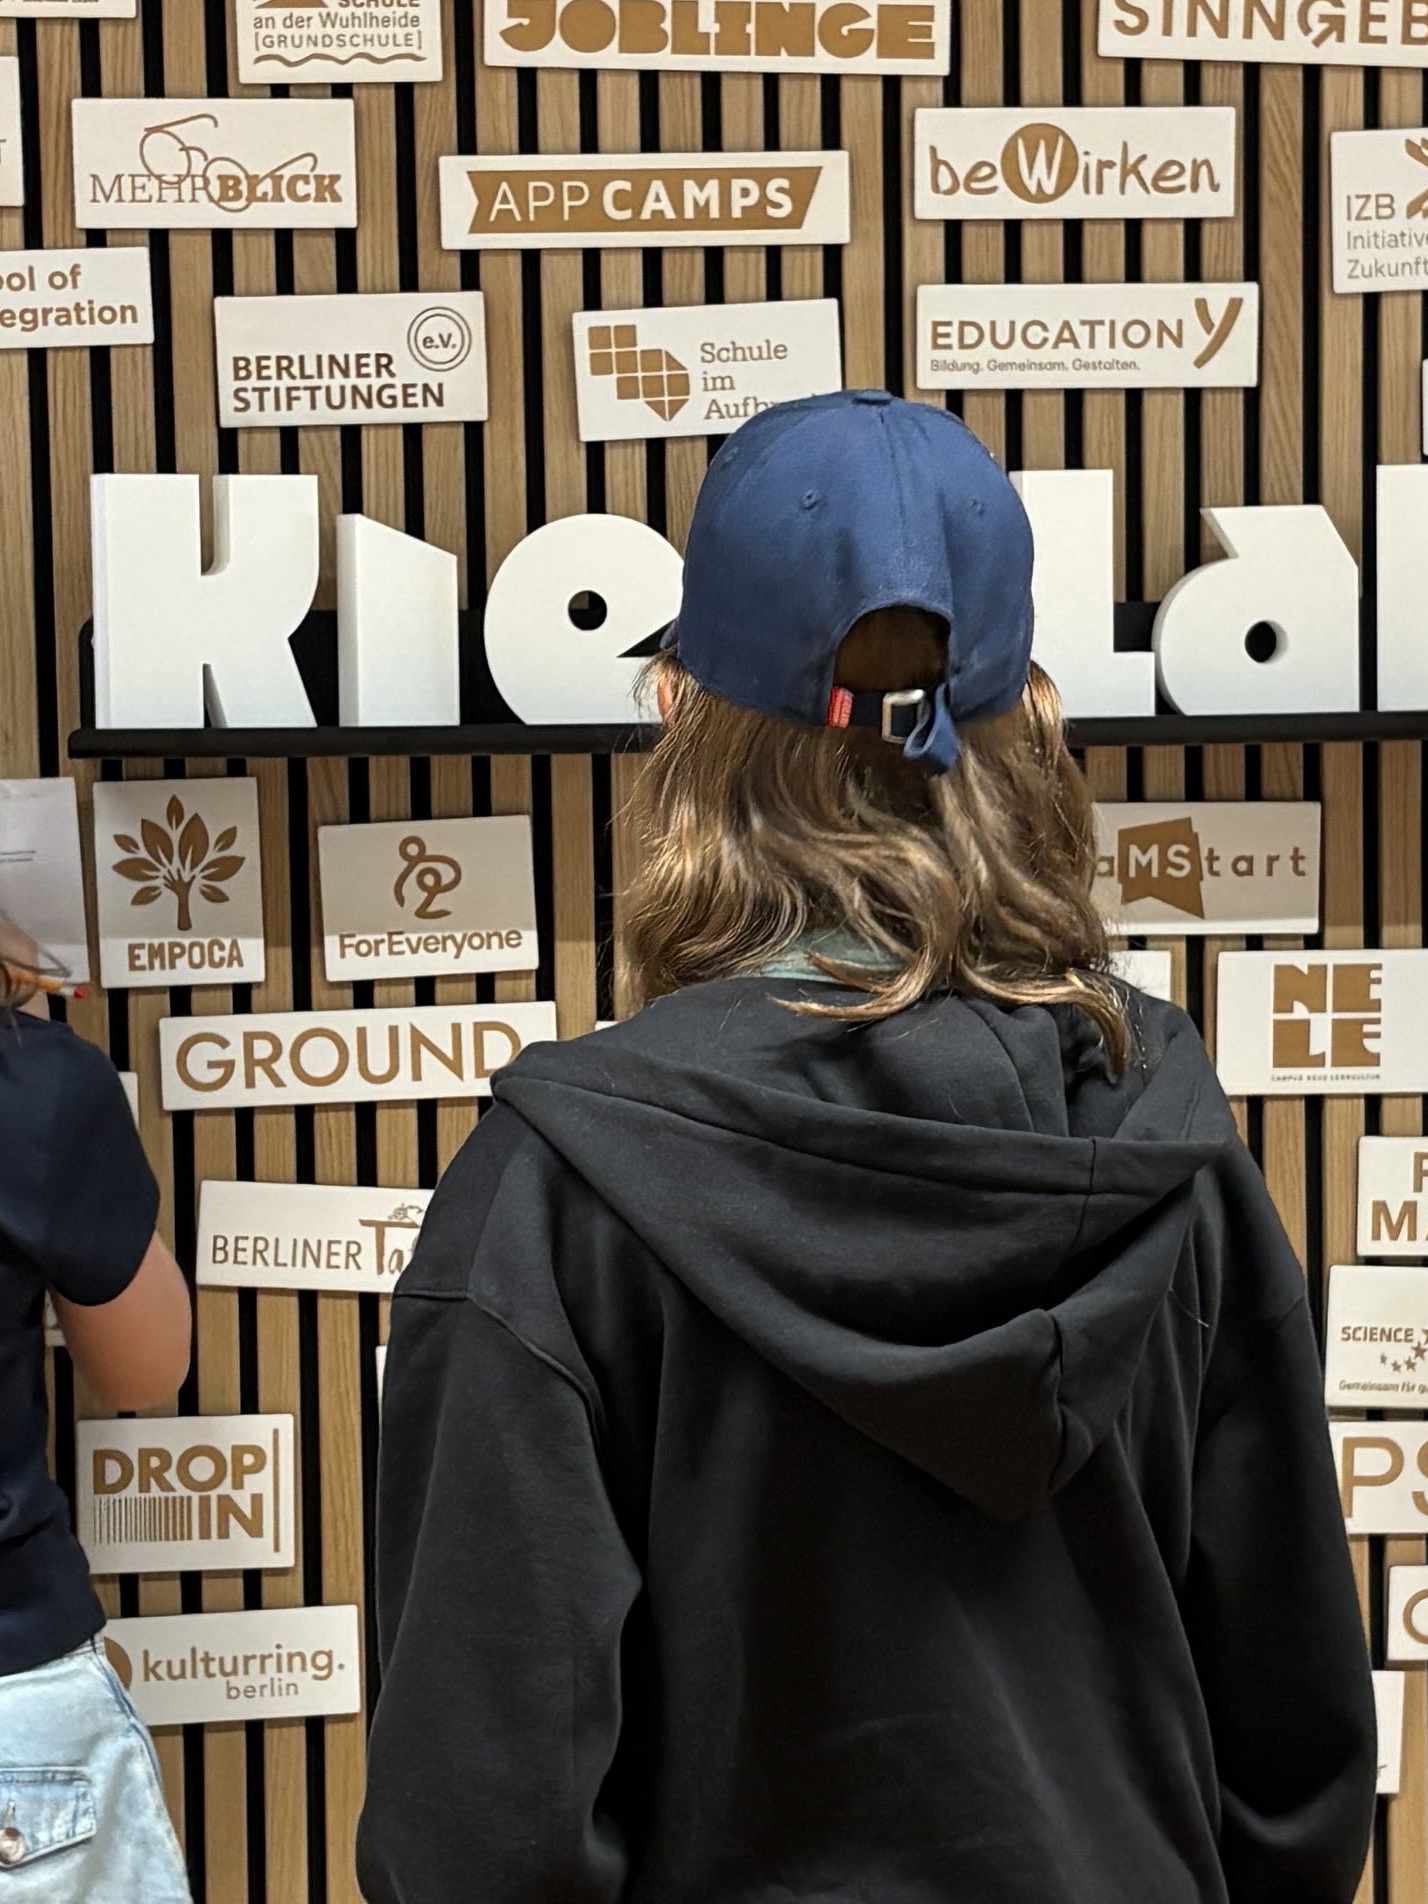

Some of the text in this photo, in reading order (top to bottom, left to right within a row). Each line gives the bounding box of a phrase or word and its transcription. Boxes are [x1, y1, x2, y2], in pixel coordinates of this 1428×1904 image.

[253, 10, 421, 31] an der Wuhlheide
[929, 133, 1221, 197] beWirken
[488, 177, 793, 223] APP CAMPS
[1346, 193, 1396, 222] IZB
[47, 264, 83, 291] of
[422, 330, 457, 350] e.V.
[700, 339, 788, 364] Schule
[232, 351, 395, 382] BERLINER
[702, 370, 736, 392] im
[930, 358, 1141, 375] Bildung. Gemeinsam. Gestalten.
[232, 383, 444, 413] STIFTUNGEN
[90, 472, 684, 728] Kie
[127, 938, 245, 973] EMPOCA
[338, 928, 523, 960] ForEveryone
[176, 1021, 523, 1092] GROUND
[212, 1234, 363, 1271] BERLINER
[1340, 1325, 1415, 1343] SCIENCE
[92, 1444, 267, 1496] DROP
[198, 1494, 264, 1540] IN
[142, 1644, 346, 1684] kulturring.
[225, 1677, 300, 1701] berlin
